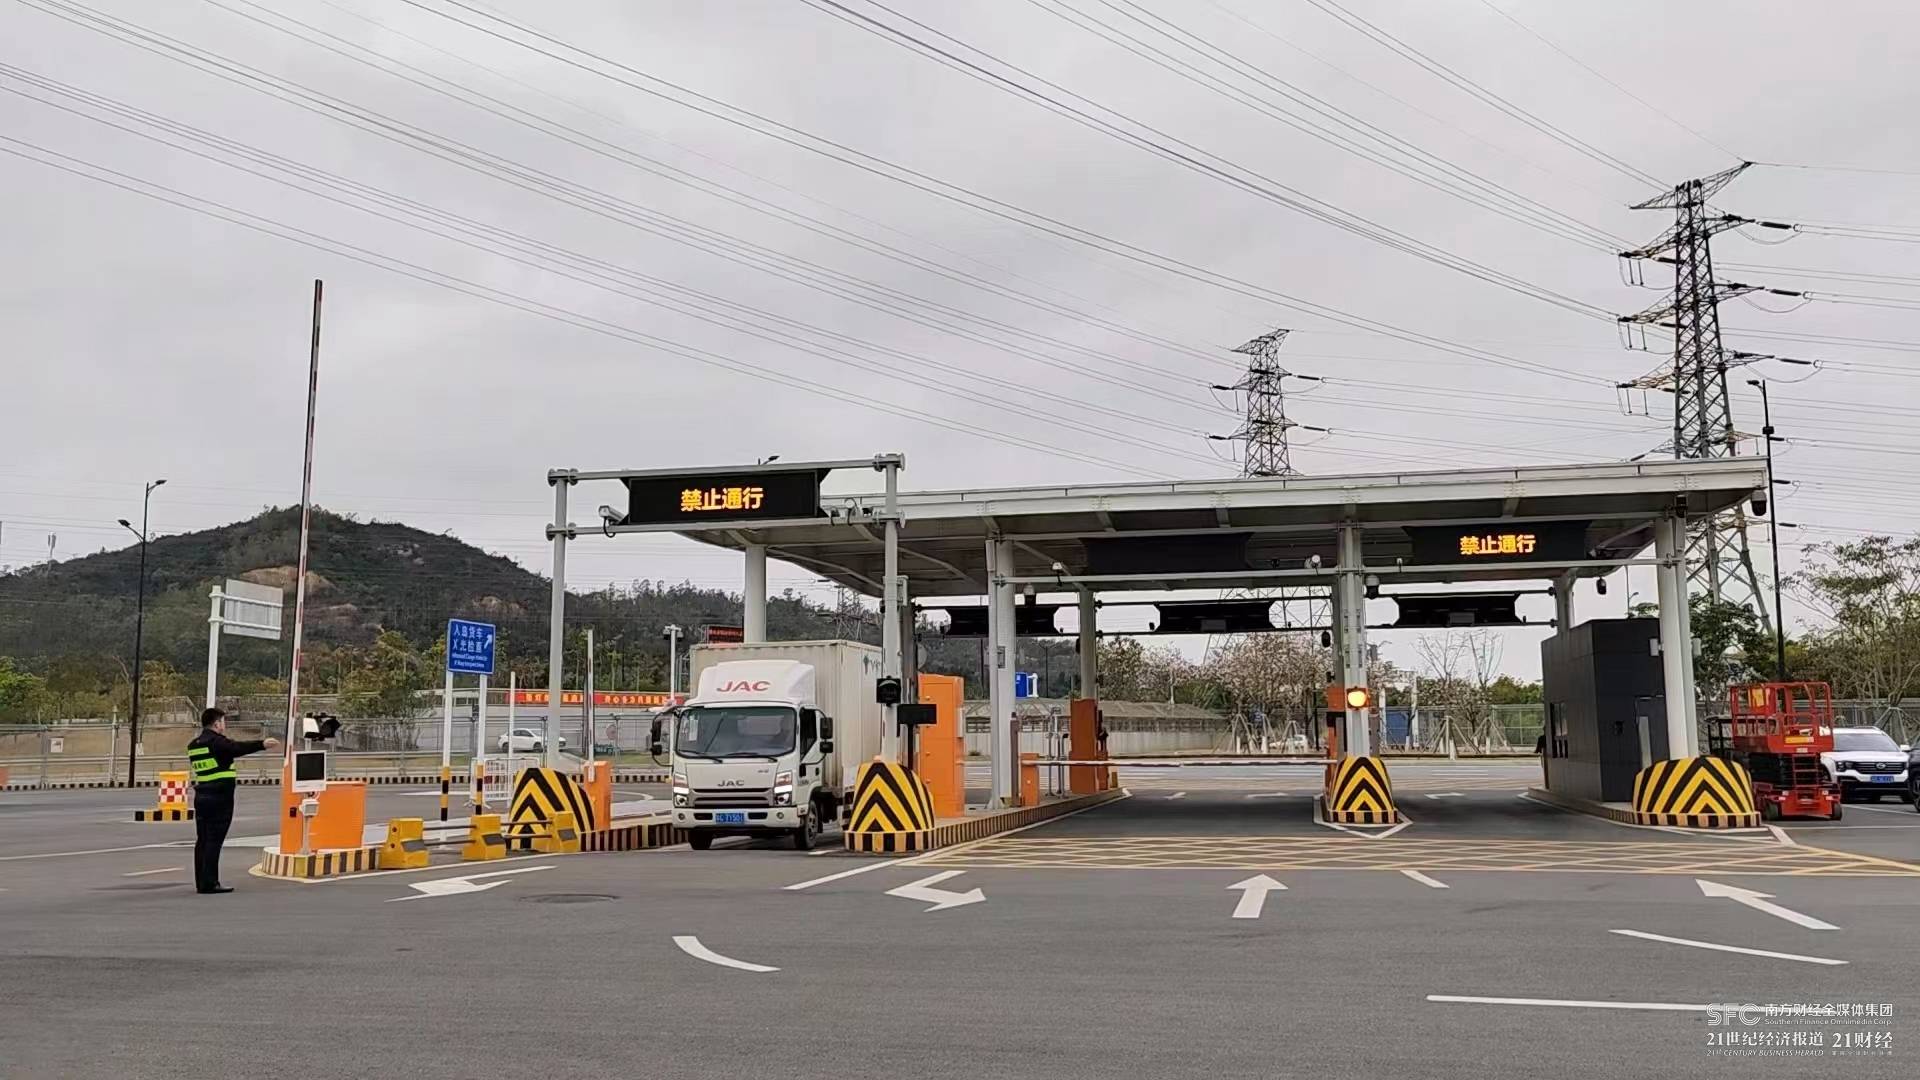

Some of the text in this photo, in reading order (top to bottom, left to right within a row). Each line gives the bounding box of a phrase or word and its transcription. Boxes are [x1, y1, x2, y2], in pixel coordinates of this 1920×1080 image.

[681, 487, 764, 512] 禁止通行
[1460, 534, 1536, 555] 禁止通行
[716, 680, 771, 693] JAC
